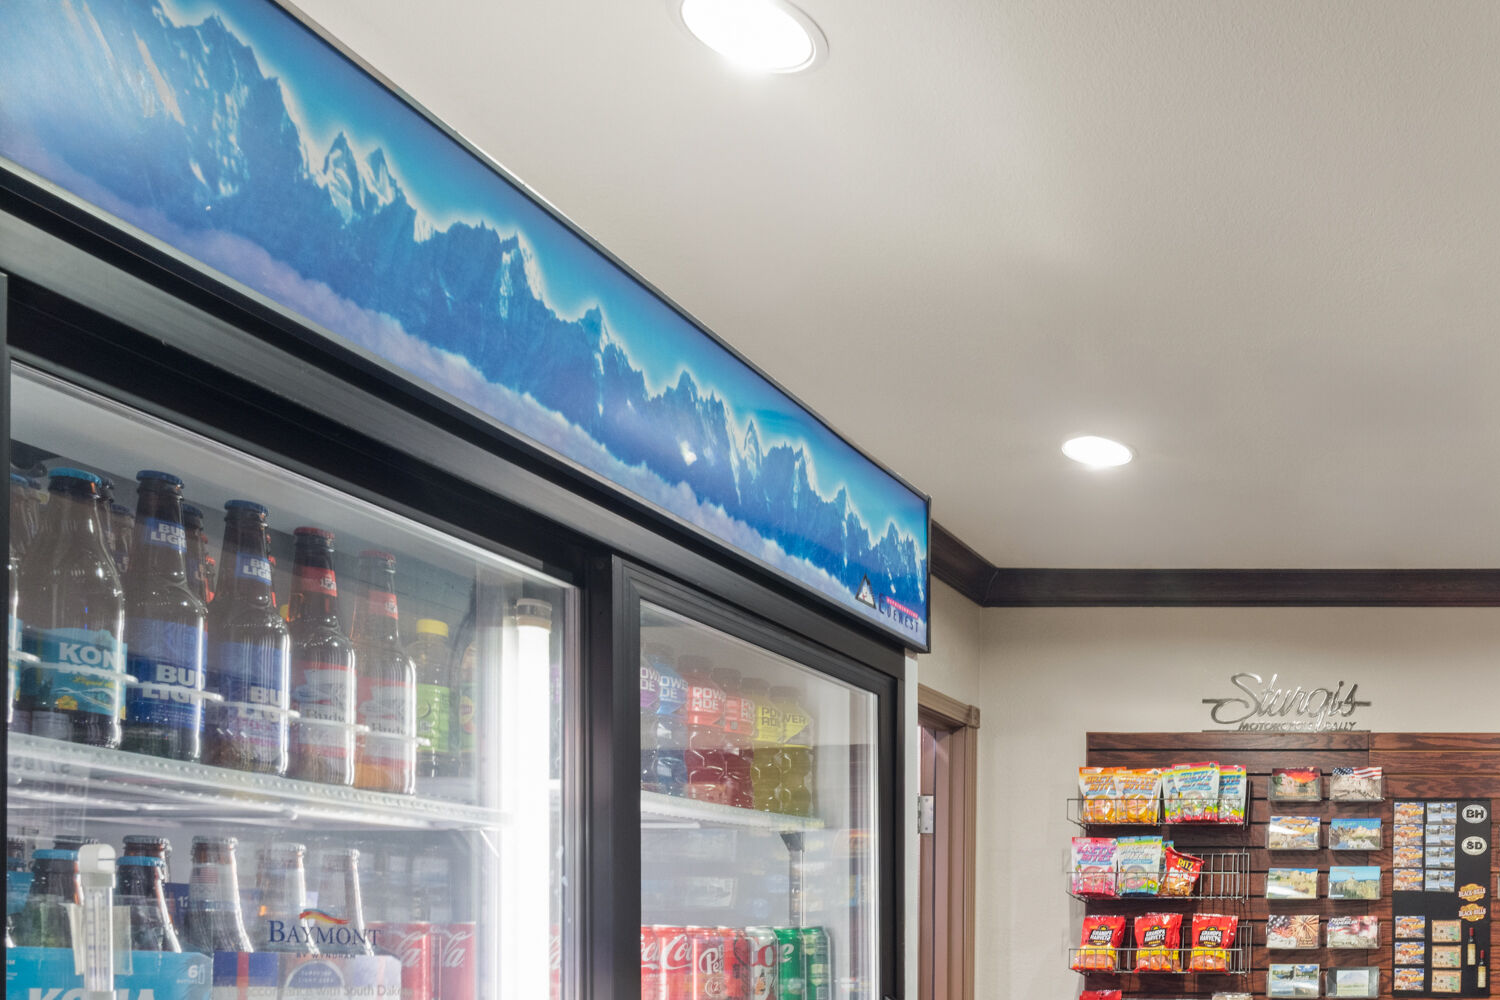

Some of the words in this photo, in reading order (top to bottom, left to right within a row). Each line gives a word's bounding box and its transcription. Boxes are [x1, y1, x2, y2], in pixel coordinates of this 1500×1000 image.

[1203, 672, 1371, 733] Sturgis
[1239, 720, 1316, 732] MOTORCYCLE
[1325, 720, 1357, 732] RALLY
[1466, 809, 1484, 819] BH
[1466, 841, 1483, 850] SD
[1177, 857, 1195, 872] RITZ
[1458, 890, 1473, 898] BLACK
[1473, 887, 1486, 895] HILLS
[1458, 910, 1473, 918] BLACK
[1473, 908, 1487, 916] HILLS
[268, 919, 382, 946] BAYMONT
[187, 965, 199, 979] 6
[343, 984, 374, 997] South
